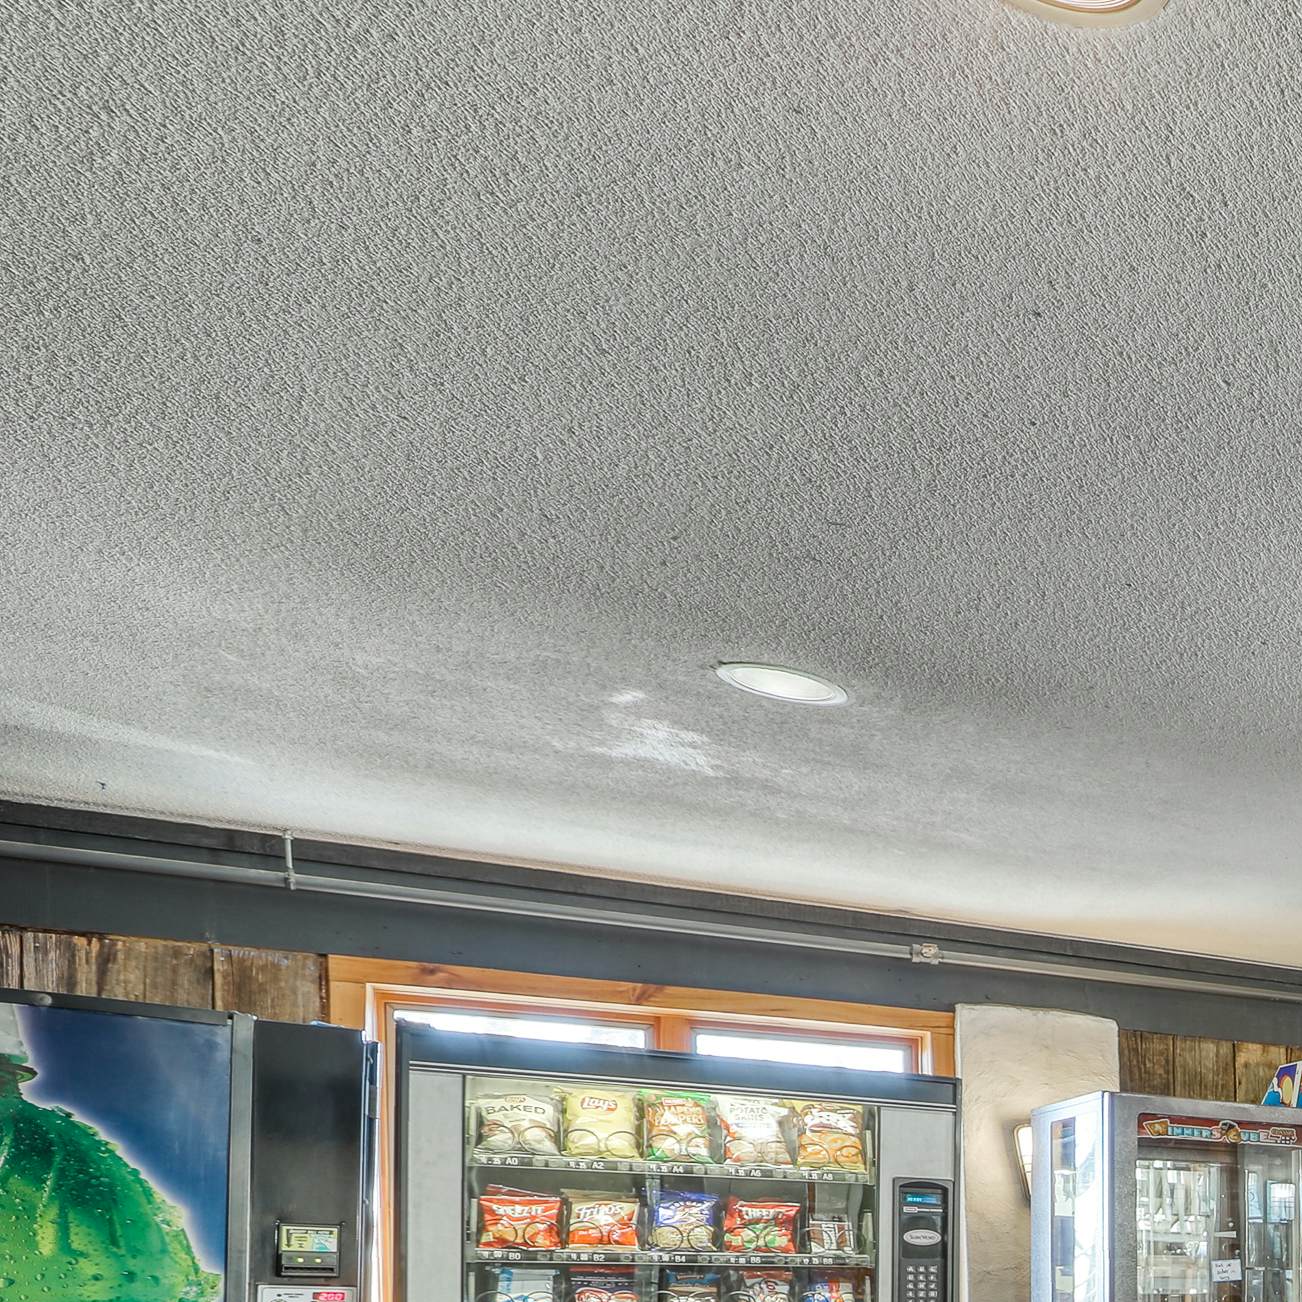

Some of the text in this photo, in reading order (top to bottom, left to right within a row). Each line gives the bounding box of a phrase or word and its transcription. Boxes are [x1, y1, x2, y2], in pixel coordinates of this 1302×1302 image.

[486, 1104, 546, 1115] BAKED
[1227, 1128, 1269, 1143] CUBE
[593, 1254, 605, 1262] B2
